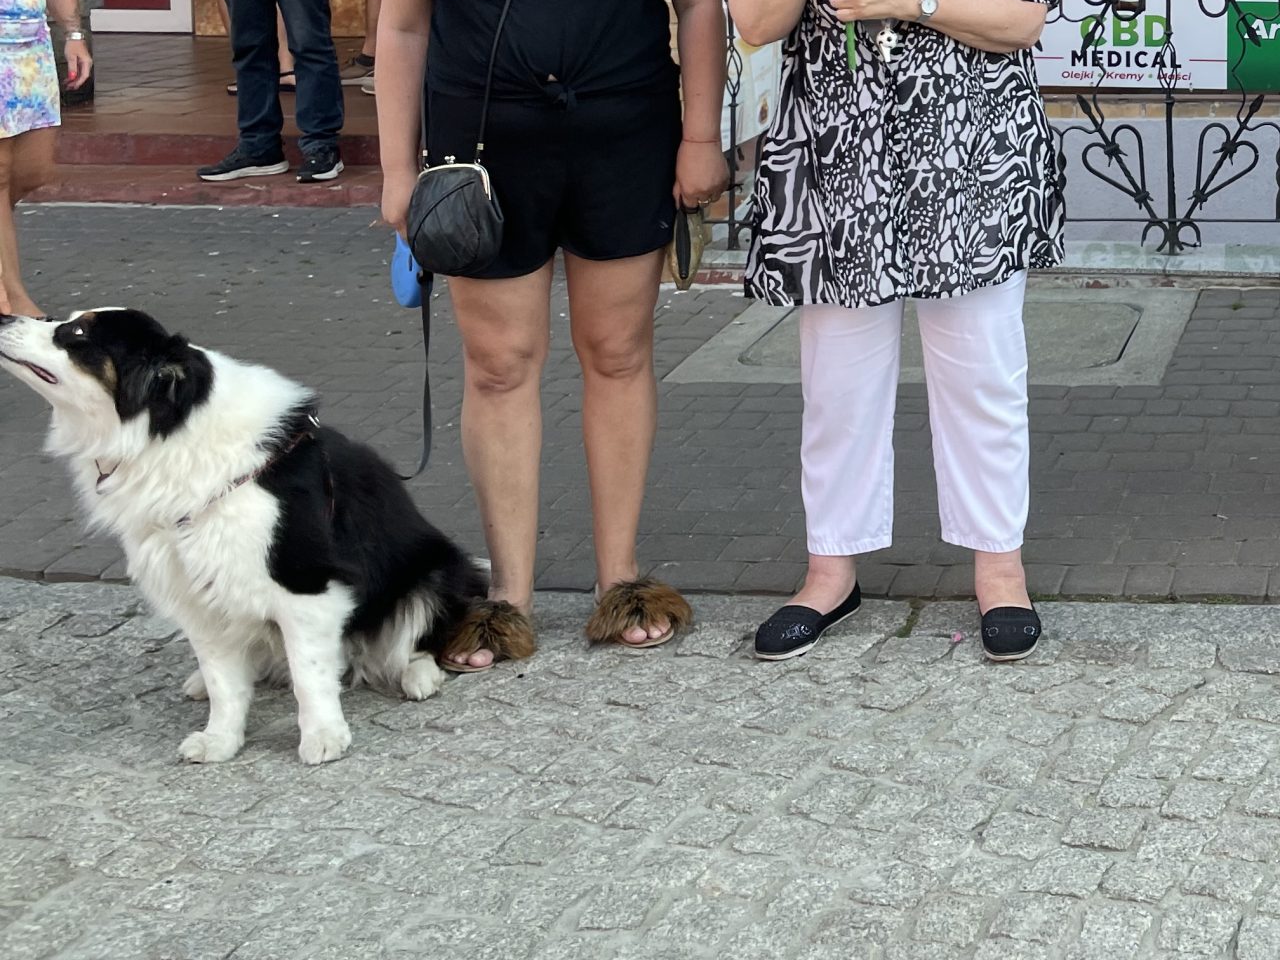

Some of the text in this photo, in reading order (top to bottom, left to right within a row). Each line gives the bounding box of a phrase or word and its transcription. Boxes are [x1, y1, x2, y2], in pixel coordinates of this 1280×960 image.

[1080, 14, 1168, 47] CBD
[1071, 50, 1182, 69] MEDICAL
[1061, 71, 1094, 80] Olejki
[1105, 71, 1145, 82] Kremy
